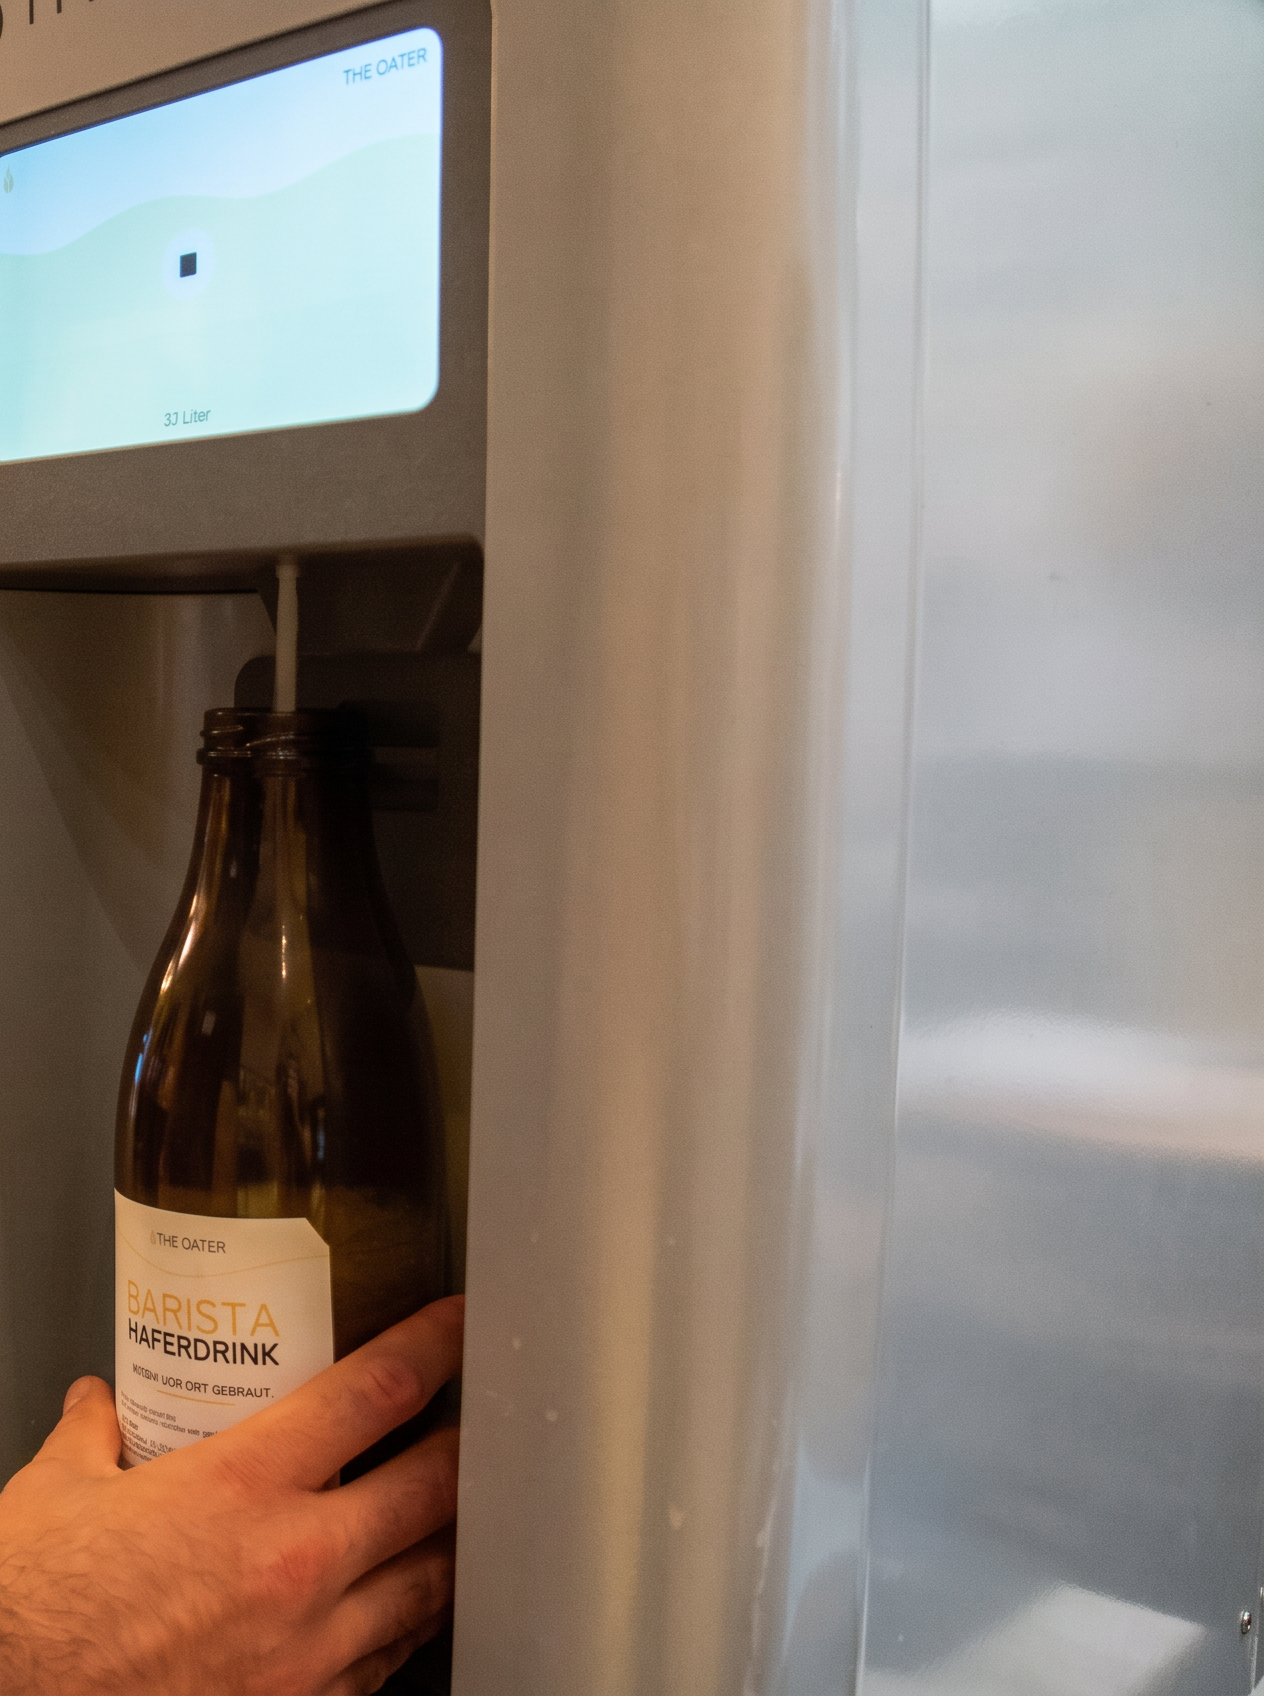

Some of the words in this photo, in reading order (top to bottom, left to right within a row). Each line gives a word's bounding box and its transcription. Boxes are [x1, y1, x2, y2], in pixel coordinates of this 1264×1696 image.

[343, 63, 372, 85] THE
[376, 47, 427, 75] OATER
[182, 409, 211, 425] Liter
[156, 1232, 179, 1249] THE
[181, 1237, 226, 1254] OATER
[127, 1279, 280, 1338] BARISTA
[128, 1317, 280, 1367] HAFERDRINK
[185, 1380, 209, 1394] ORT
